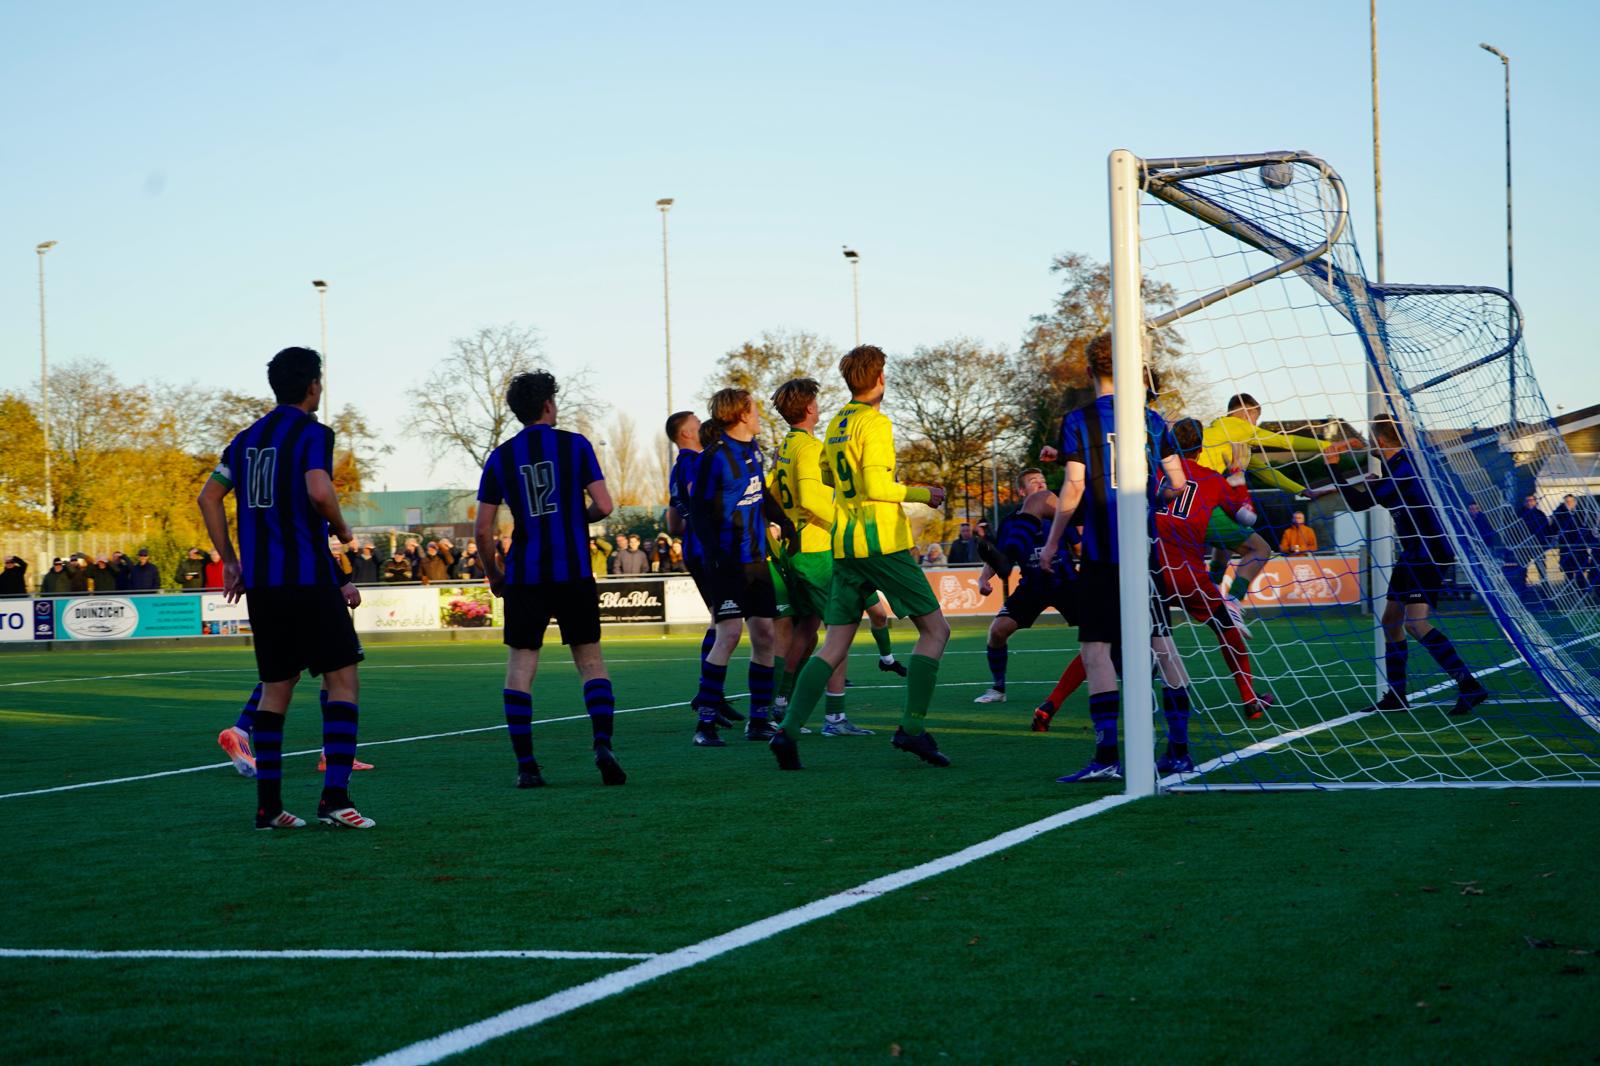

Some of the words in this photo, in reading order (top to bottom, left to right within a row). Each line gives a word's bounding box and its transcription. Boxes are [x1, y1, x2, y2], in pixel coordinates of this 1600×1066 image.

[246, 447, 276, 508] 10
[520, 461, 558, 517] 12
[777, 468, 794, 509] 6
[836, 450, 856, 499] 9
[75, 606, 124, 618] DUINZICHT
